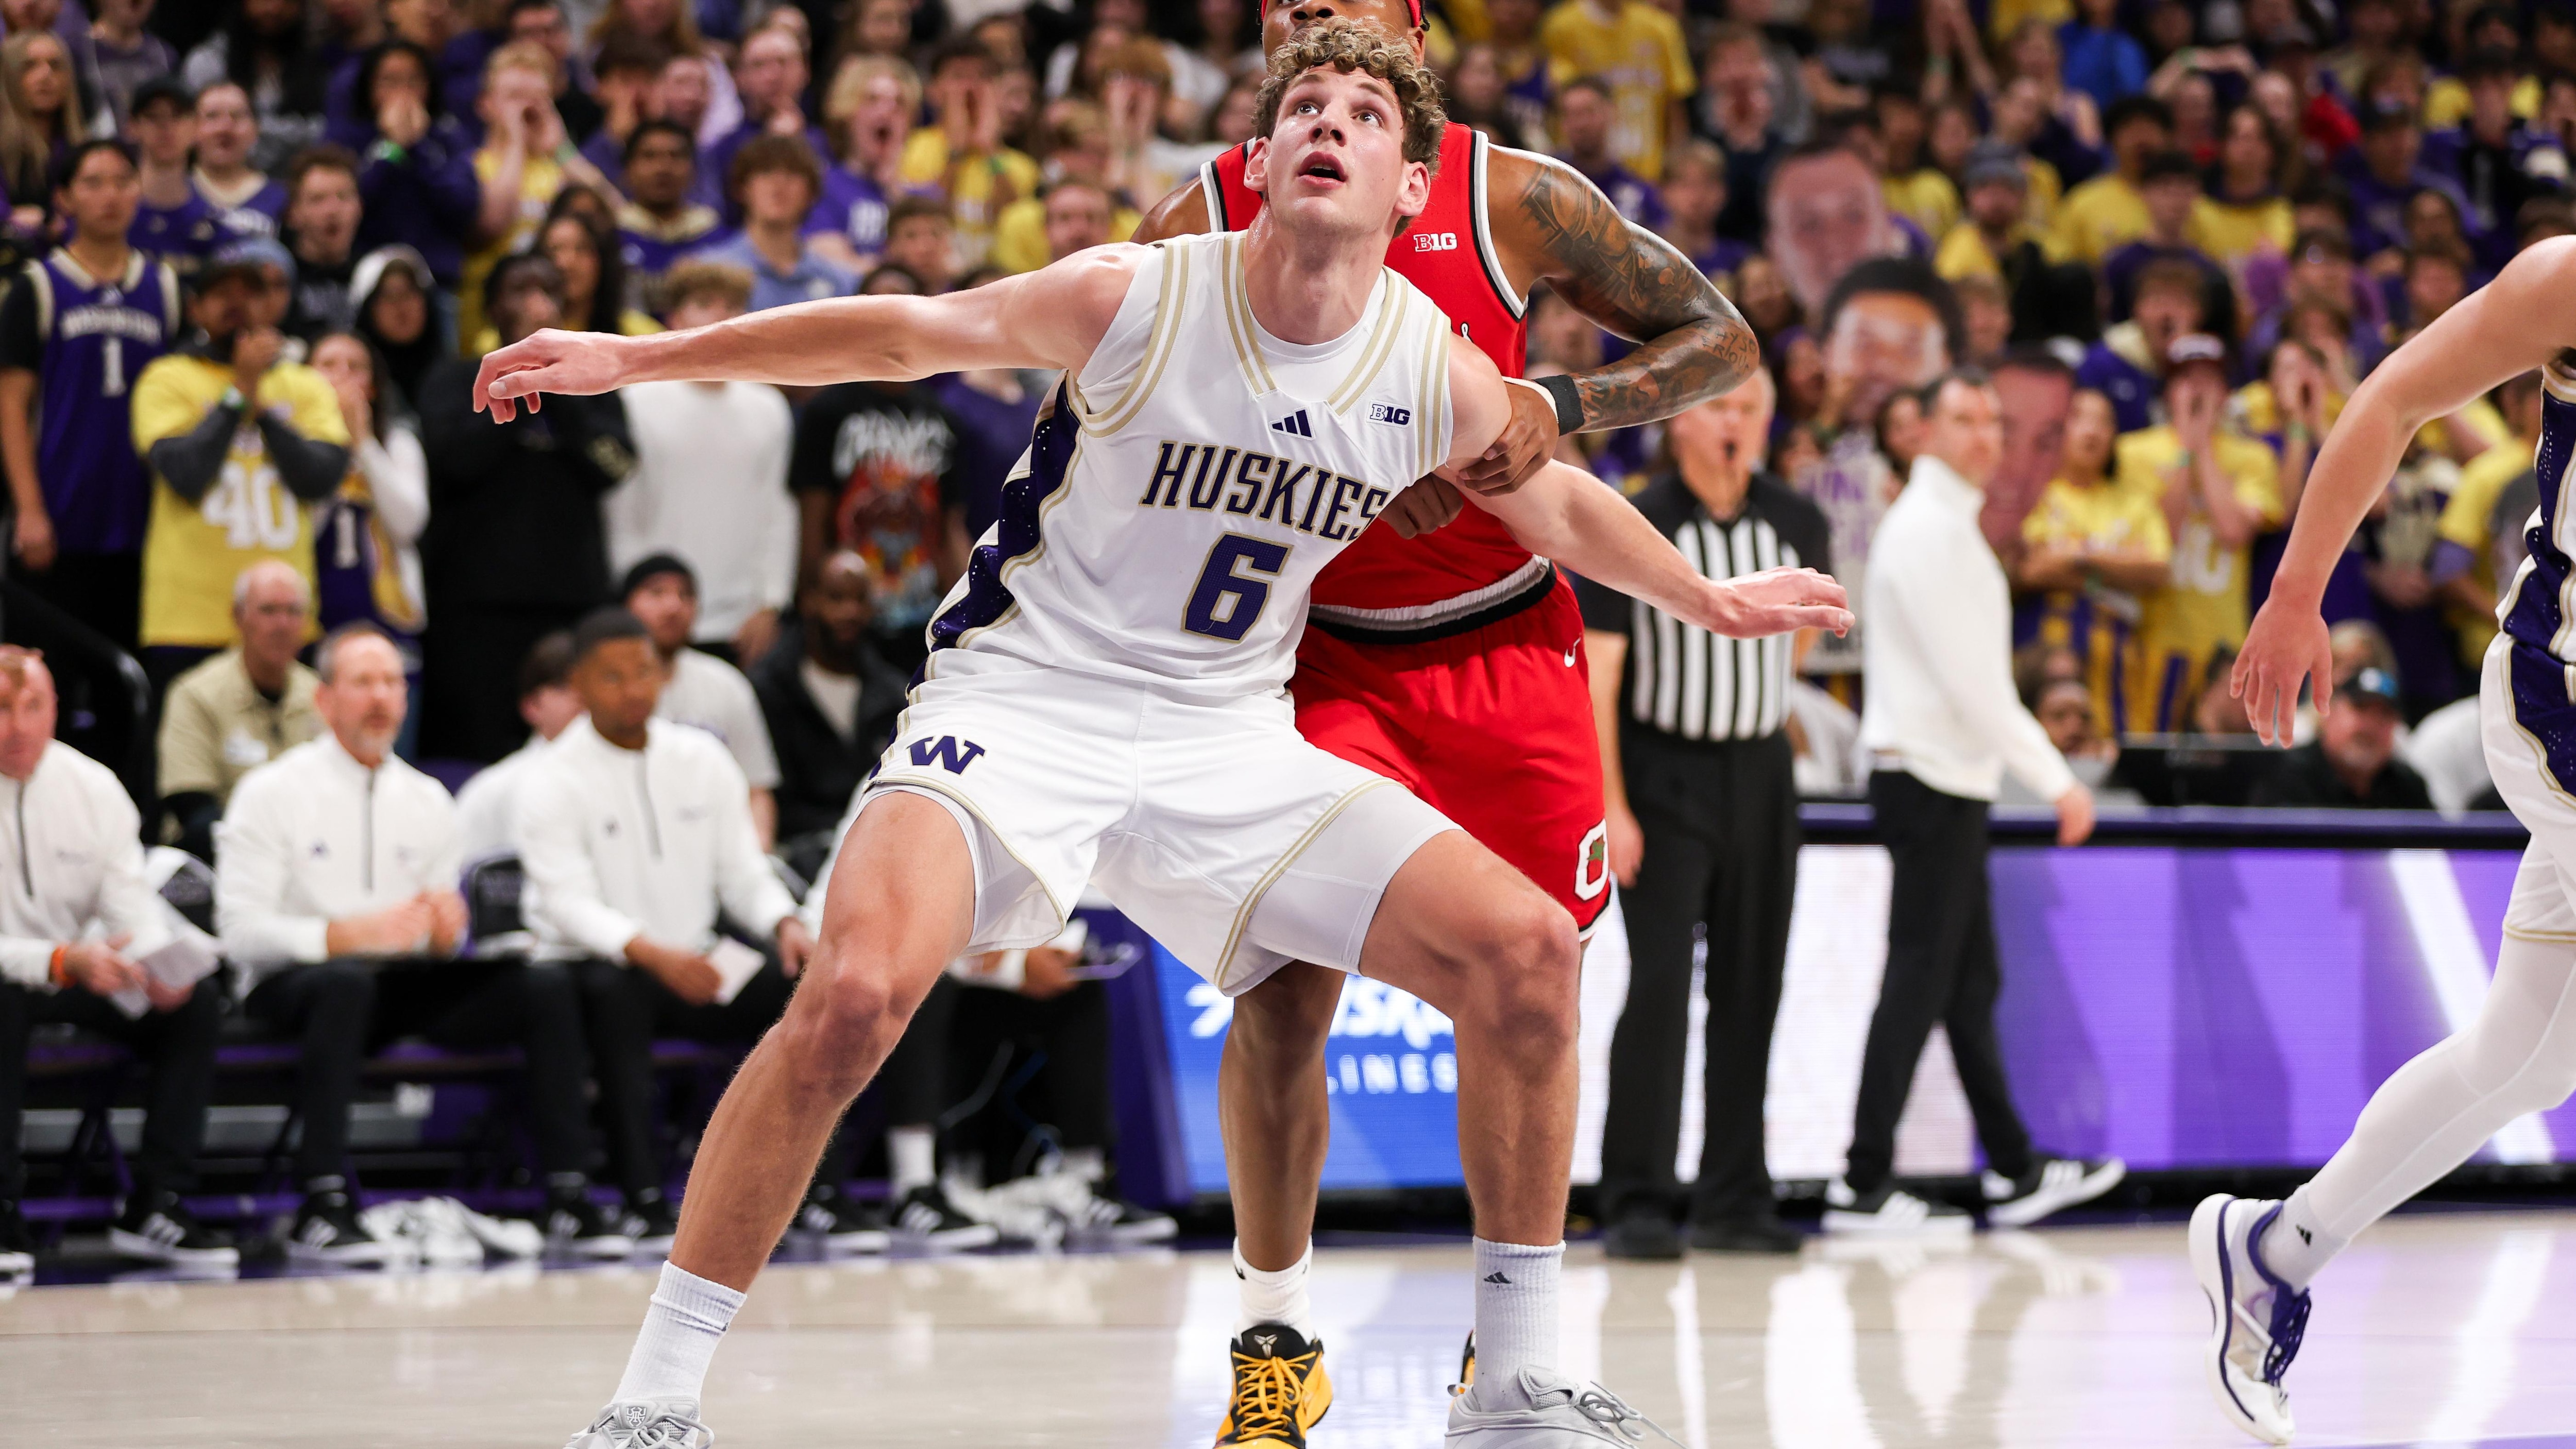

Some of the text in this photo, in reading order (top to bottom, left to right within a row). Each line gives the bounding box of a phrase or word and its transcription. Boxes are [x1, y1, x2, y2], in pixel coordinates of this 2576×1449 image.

[103, 337, 126, 397] 1
[202, 462, 300, 549] 40
[1180, 530, 1294, 643] 6
[905, 735, 987, 776] W
